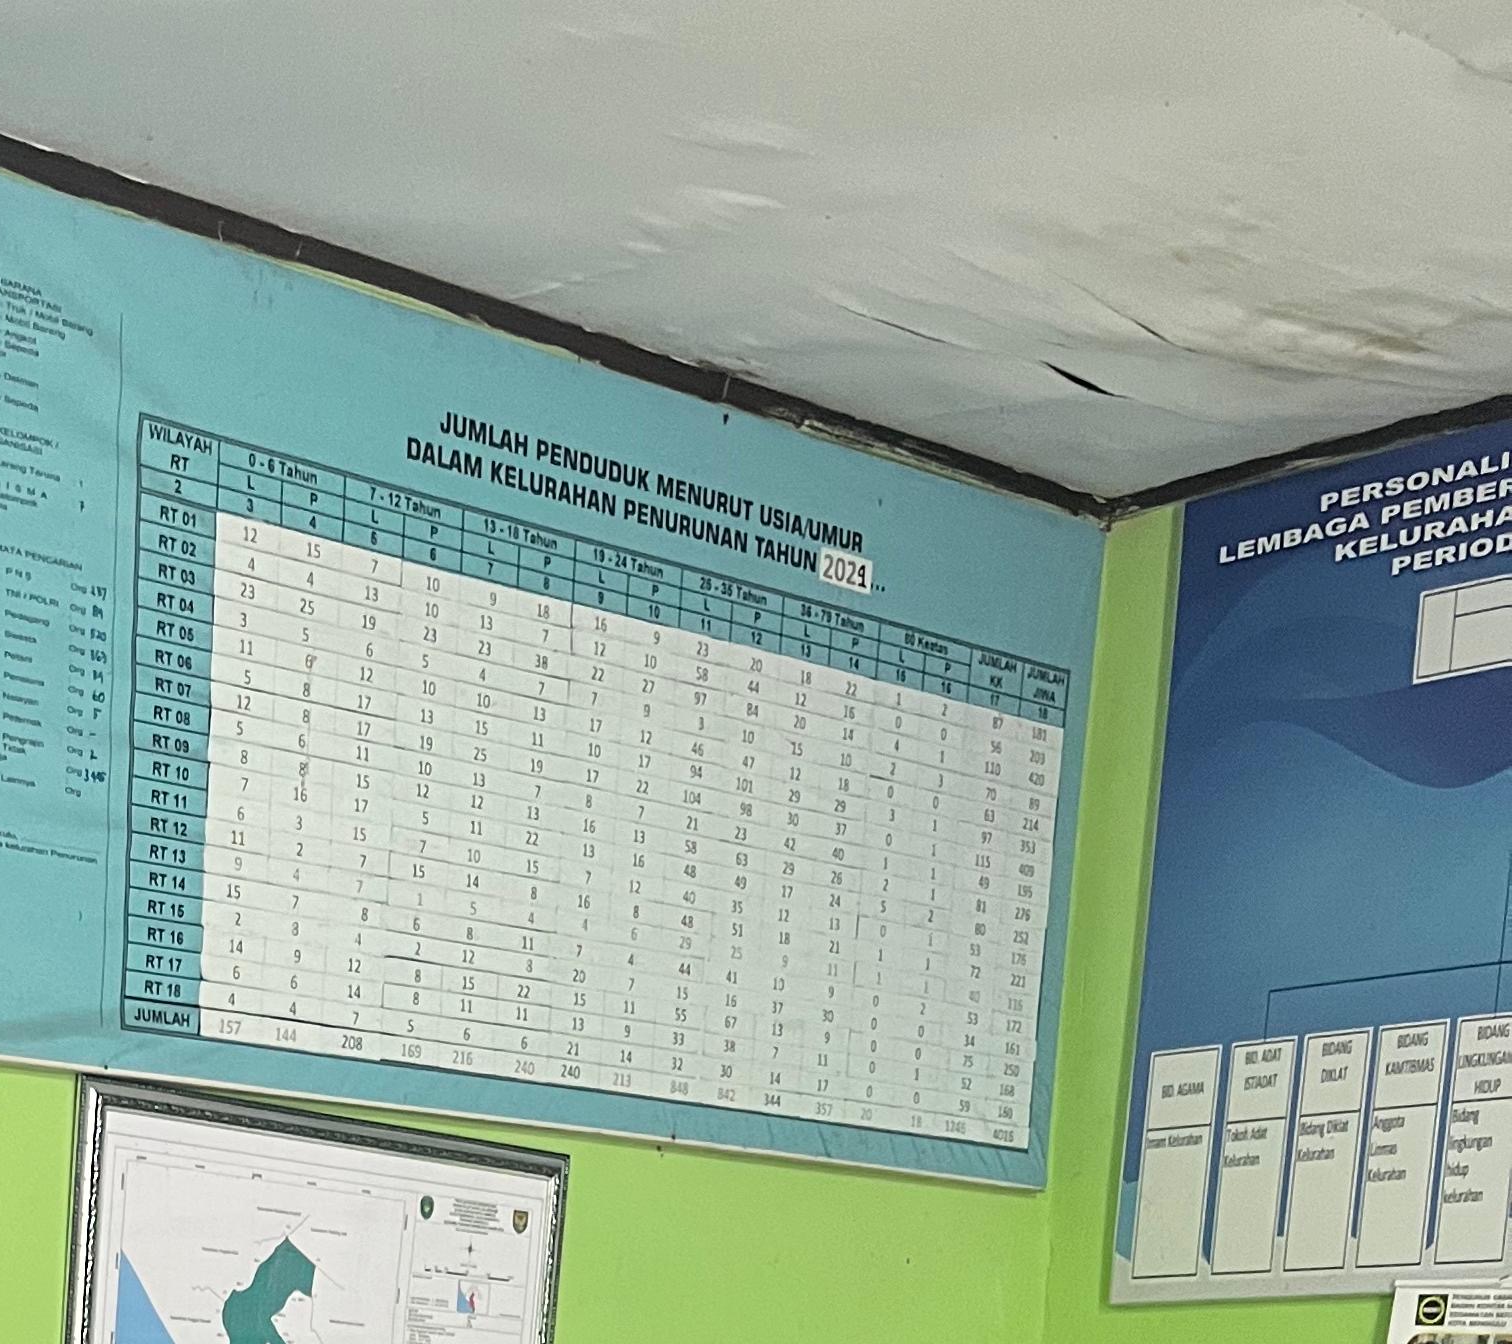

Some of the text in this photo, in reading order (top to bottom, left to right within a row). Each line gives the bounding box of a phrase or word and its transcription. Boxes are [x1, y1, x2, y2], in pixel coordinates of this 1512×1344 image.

[148, 424, 213, 456] WILAYAH
[169, 454, 190, 472] RT
[440, 411, 863, 553] JUMLAH PENDUDUK MENURUT USIA/UMUR
[1320, 450, 1510, 512] PERSONALI
[159, 505, 197, 528] RT 01
[406, 436, 483, 479] DALAM
[490, 460, 617, 517] KELURAHAN
[624, 498, 749, 554] PENURUNAN
[755, 534, 818, 573] TAHUN
[158, 534, 197, 557] RT 02
[1218, 512, 1370, 564] LEMBAGA
[152, 761, 189, 781] RT 10
[150, 817, 188, 837] RT 12
[143, 980, 181, 998] RT 18
[133, 1006, 581, 1081] JUMLAH 208 240
[1262, 1024, 1510, 1063] ADAT BIDANG BIDANG BIDANG
[1177, 1081, 1205, 1097] AGAMA
[1320, 1066, 1349, 1084] DIKLAT
[1474, 1078, 1501, 1096] HIDUP
